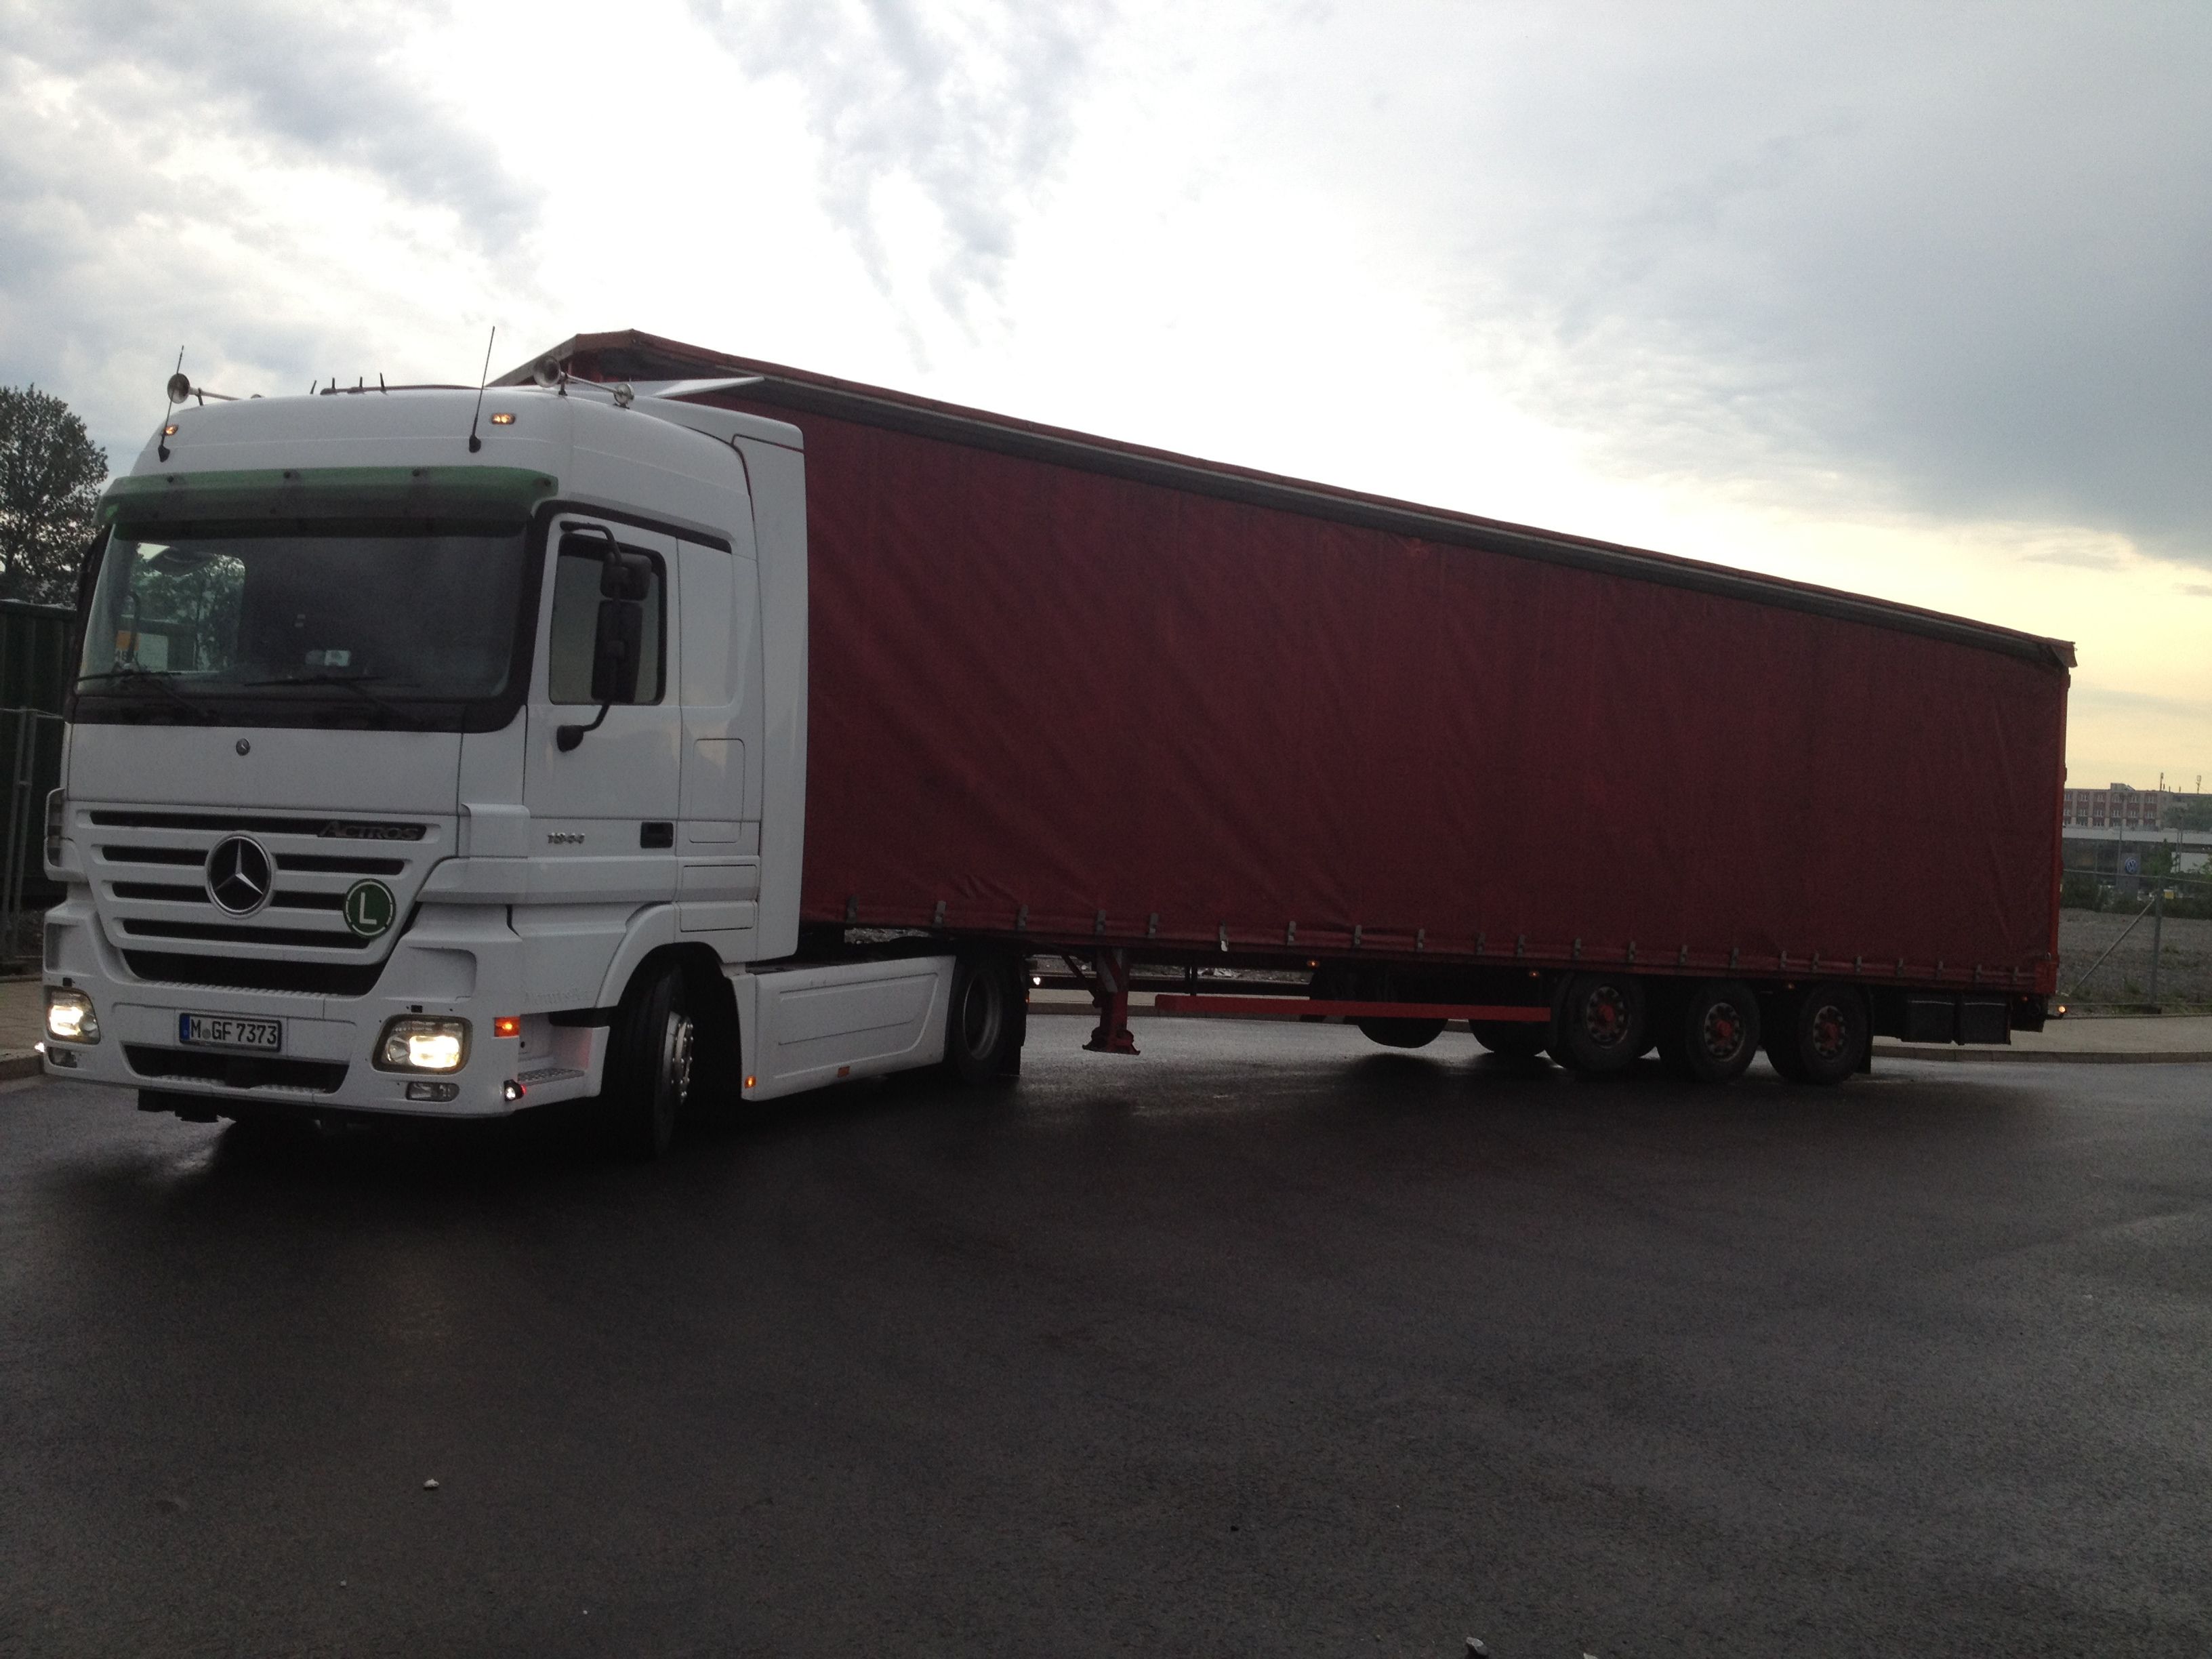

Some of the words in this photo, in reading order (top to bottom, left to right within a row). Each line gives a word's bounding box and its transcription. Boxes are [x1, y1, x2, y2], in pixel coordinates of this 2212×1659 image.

[359, 892, 377, 924] L
[190, 1019, 201, 1038] M
[211, 1021, 232, 1040] GF
[236, 1023, 276, 1044] 7373
